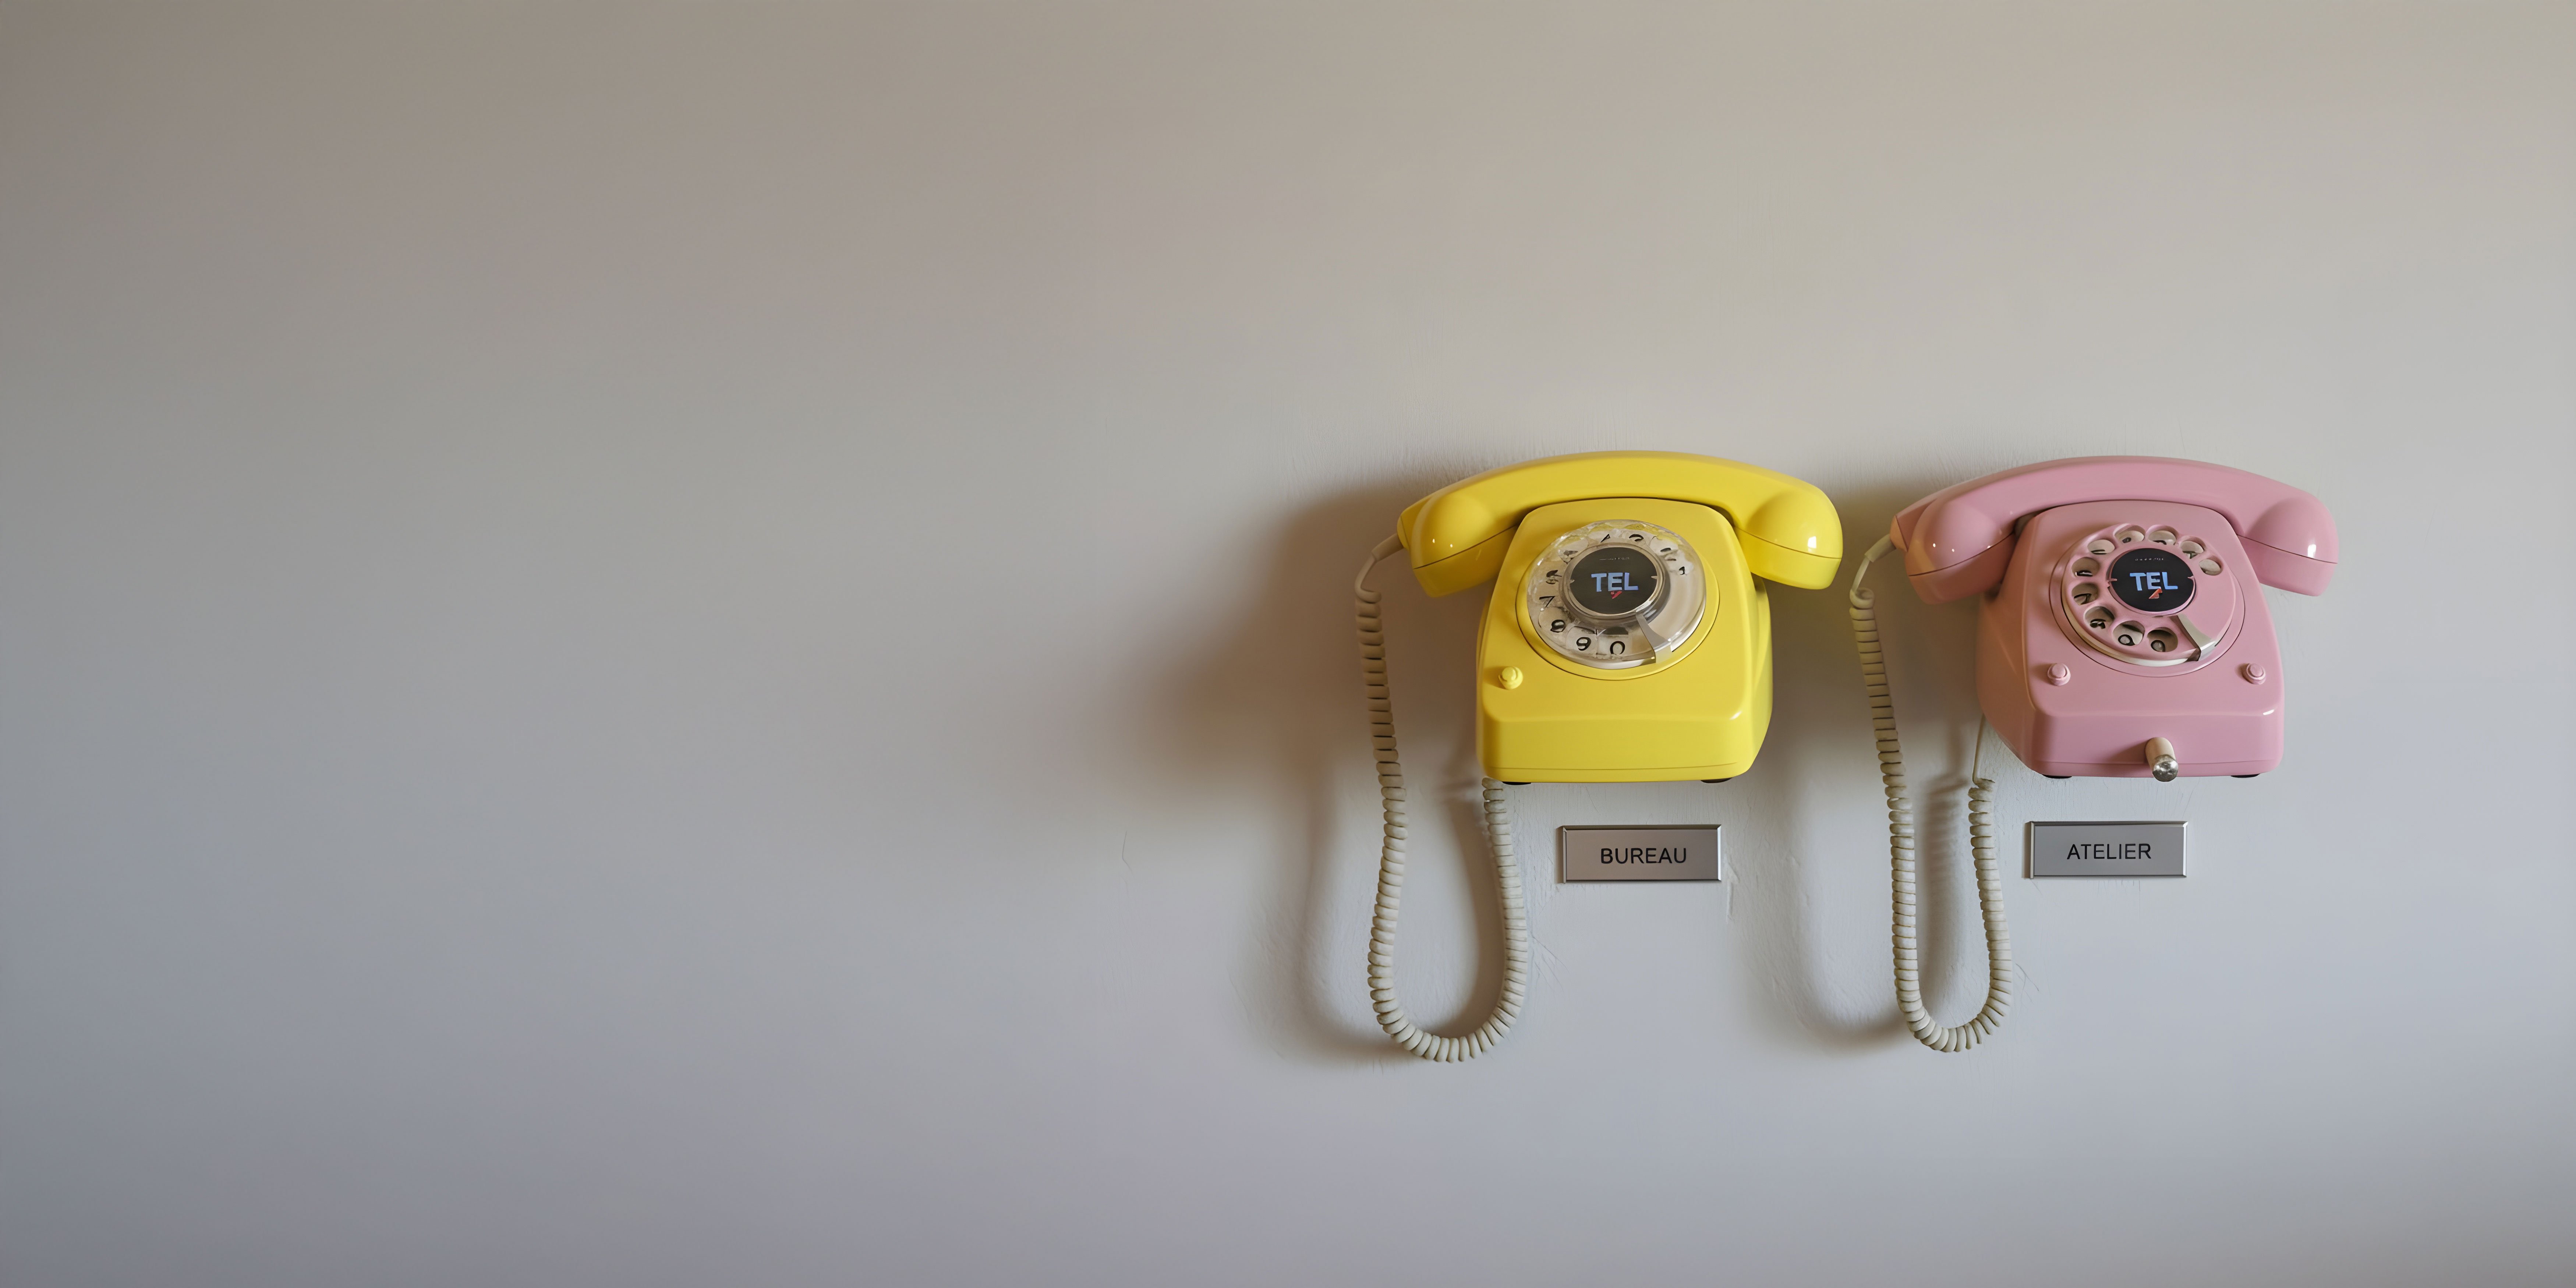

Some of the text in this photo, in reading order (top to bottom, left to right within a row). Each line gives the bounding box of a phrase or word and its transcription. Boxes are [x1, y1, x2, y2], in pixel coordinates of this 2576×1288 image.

[1591, 572, 1639, 592] TEL
[2130, 572, 2178, 591] TEL
[1576, 637, 1591, 651] 9
[1610, 641, 1625, 655] 0
[1601, 848, 1687, 864] BUREAU
[2067, 843, 2152, 860] ATELIER
